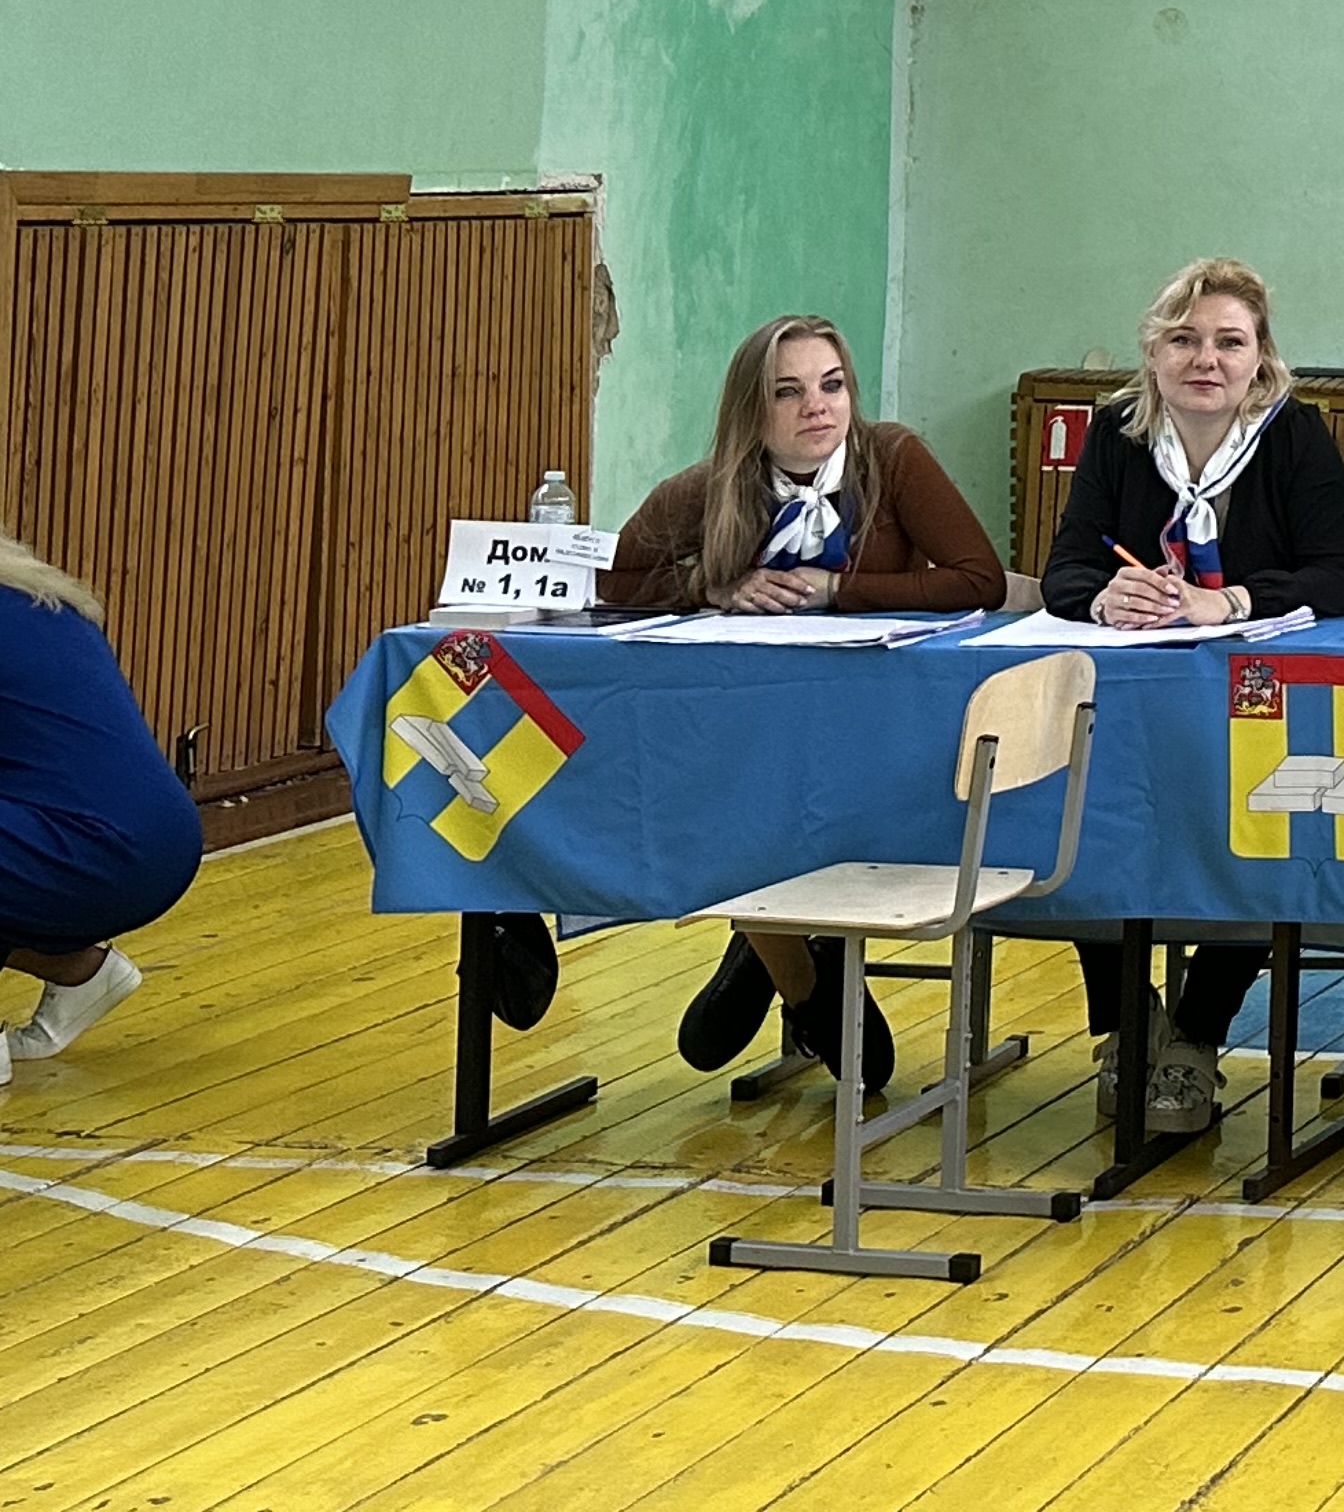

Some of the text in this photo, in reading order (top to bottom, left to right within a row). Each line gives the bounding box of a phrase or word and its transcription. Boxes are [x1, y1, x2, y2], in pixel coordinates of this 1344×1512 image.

[460, 573, 568, 600] № 1, 1а
